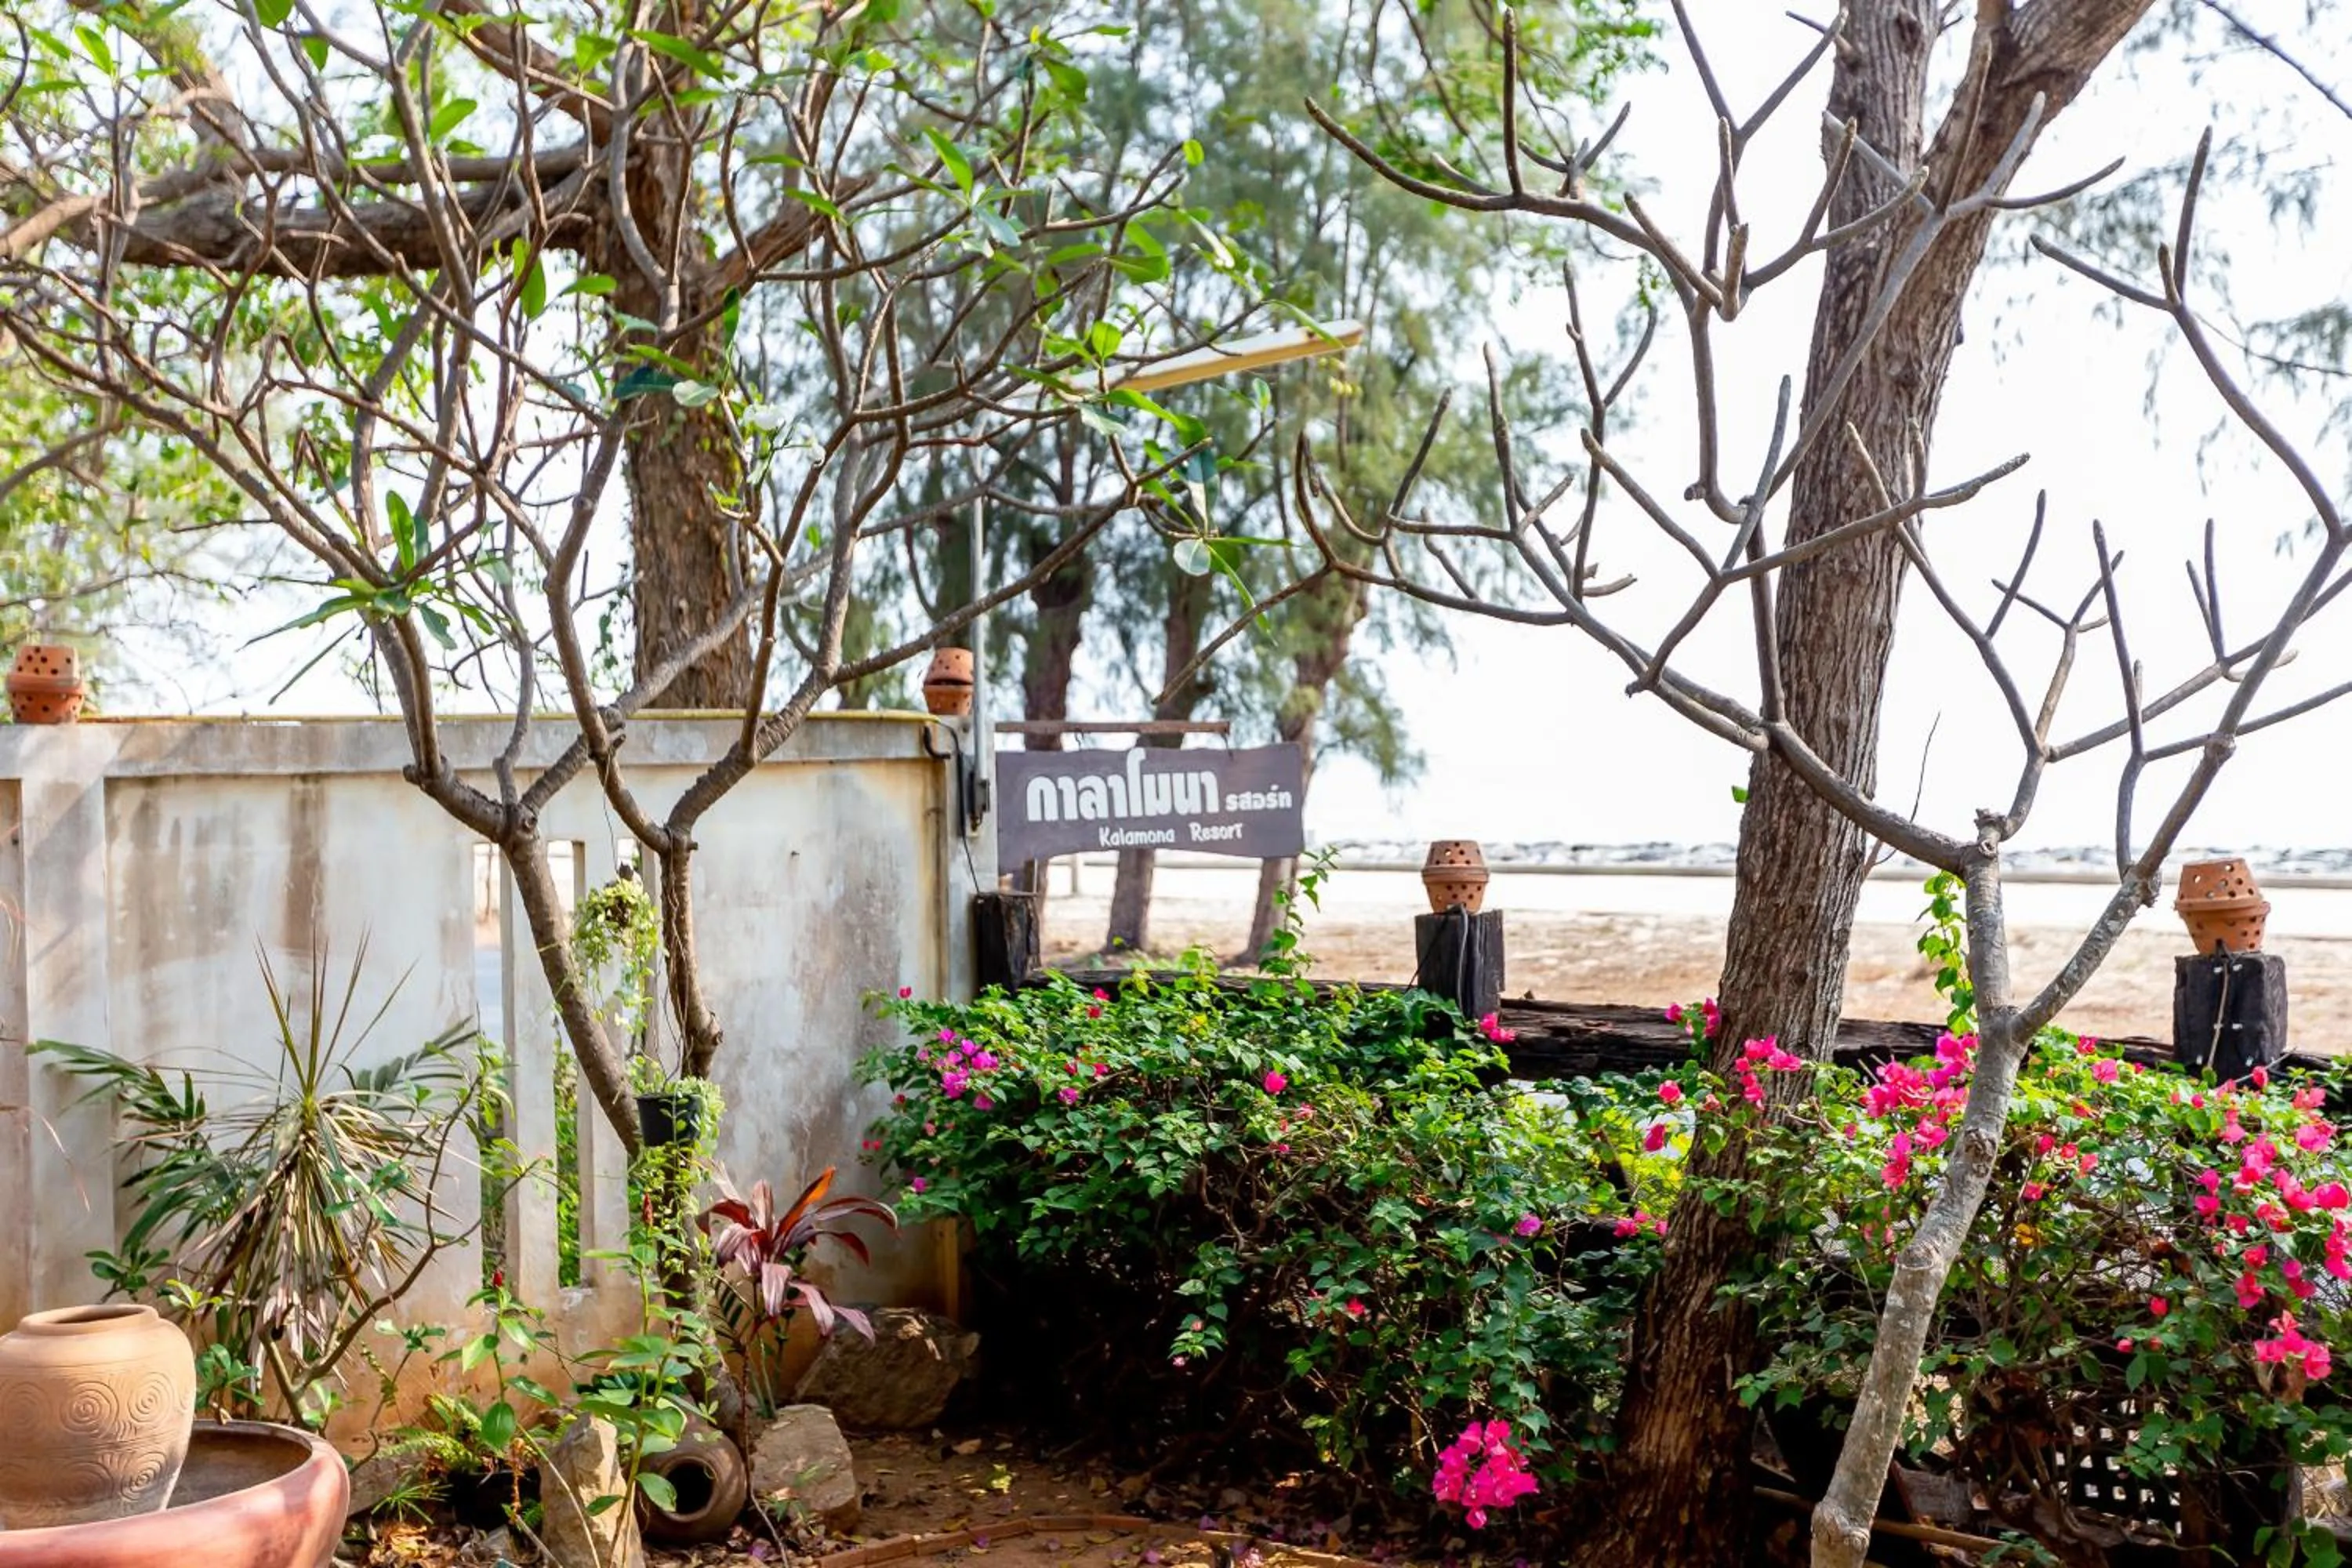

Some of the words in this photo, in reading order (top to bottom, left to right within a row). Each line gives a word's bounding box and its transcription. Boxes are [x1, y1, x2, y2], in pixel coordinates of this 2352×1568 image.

[1026, 747, 1220, 821] กาลาโมนา
[1098, 826, 1176, 847] Kalamona
[1189, 822, 1243, 842] Resort
